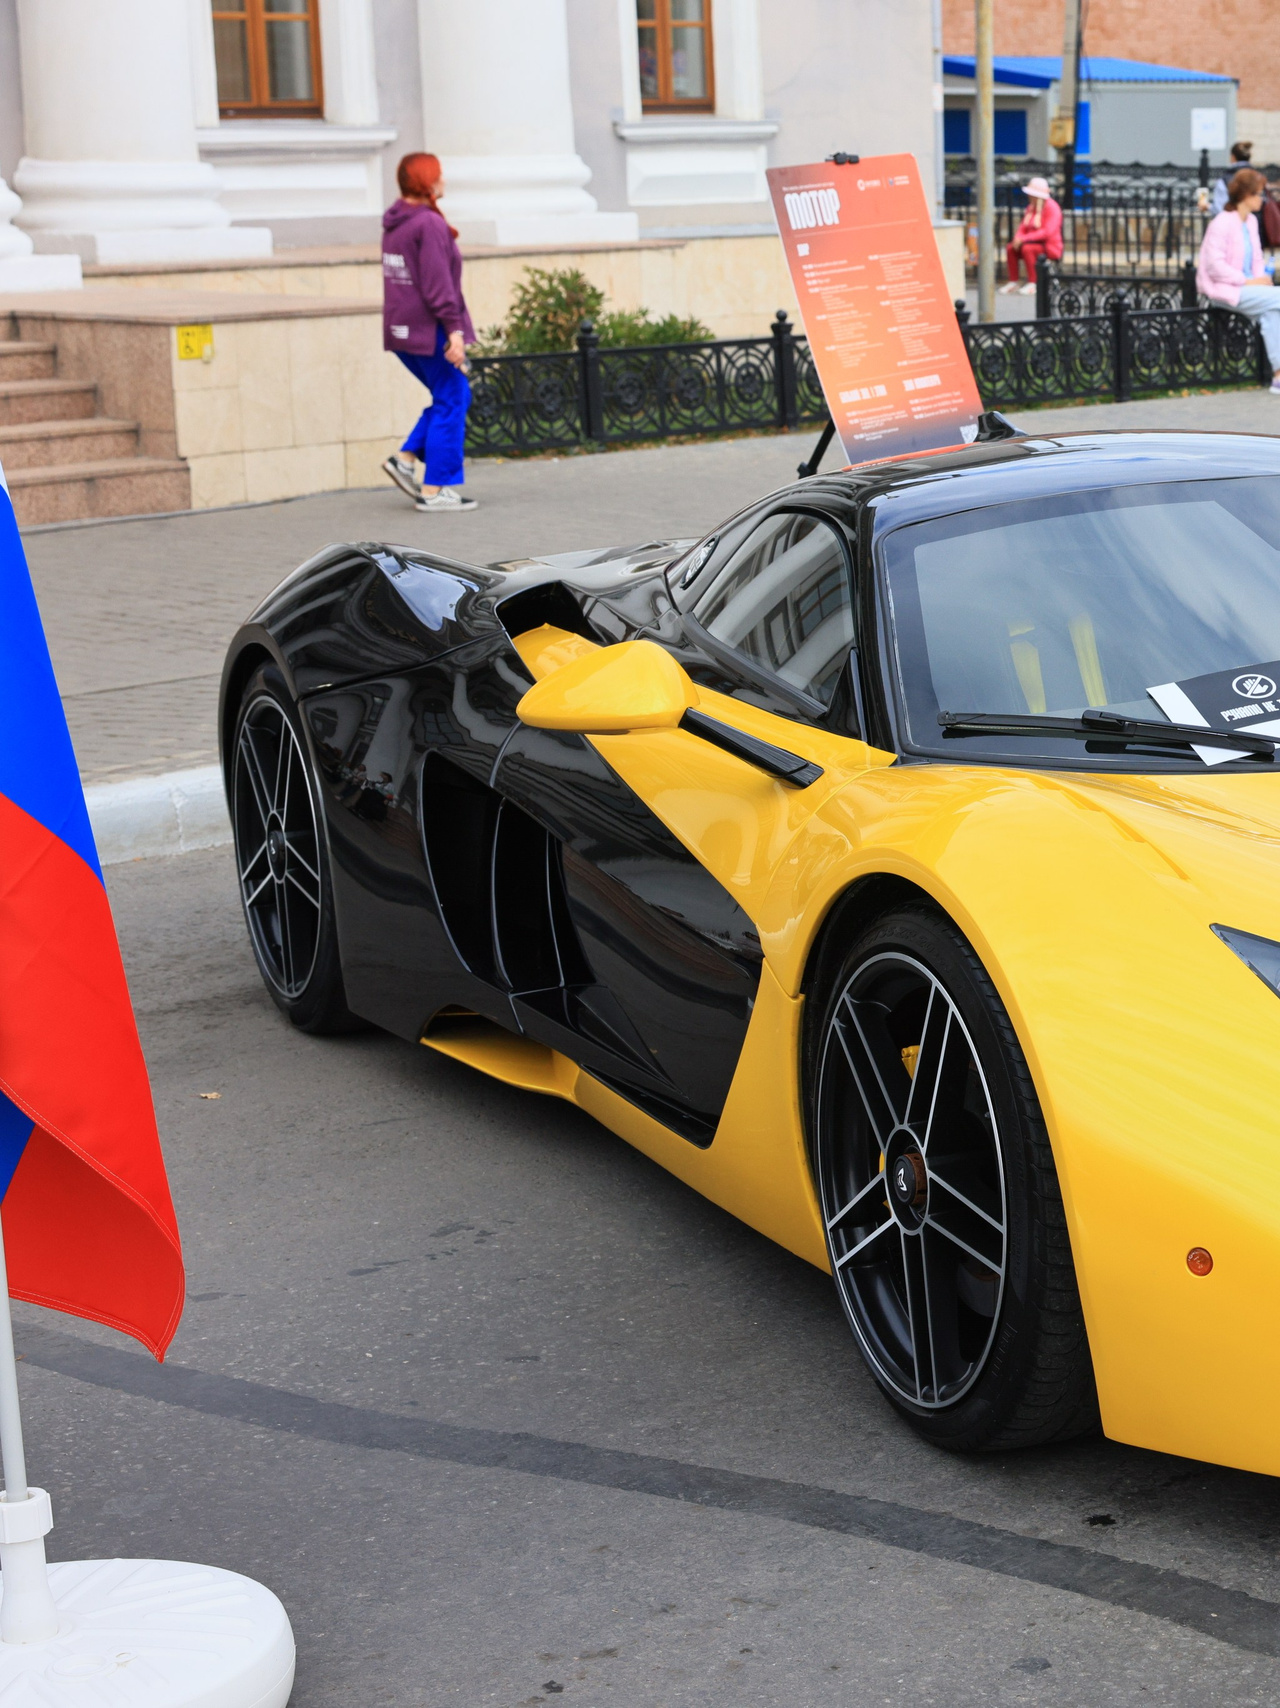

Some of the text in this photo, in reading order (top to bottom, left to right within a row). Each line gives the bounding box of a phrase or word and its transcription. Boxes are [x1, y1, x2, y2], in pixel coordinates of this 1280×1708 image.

[784, 188, 841, 230] МОТОР
[1220, 704, 1264, 722] РУКАМИ
[1262, 701, 1280, 713] НЕ
